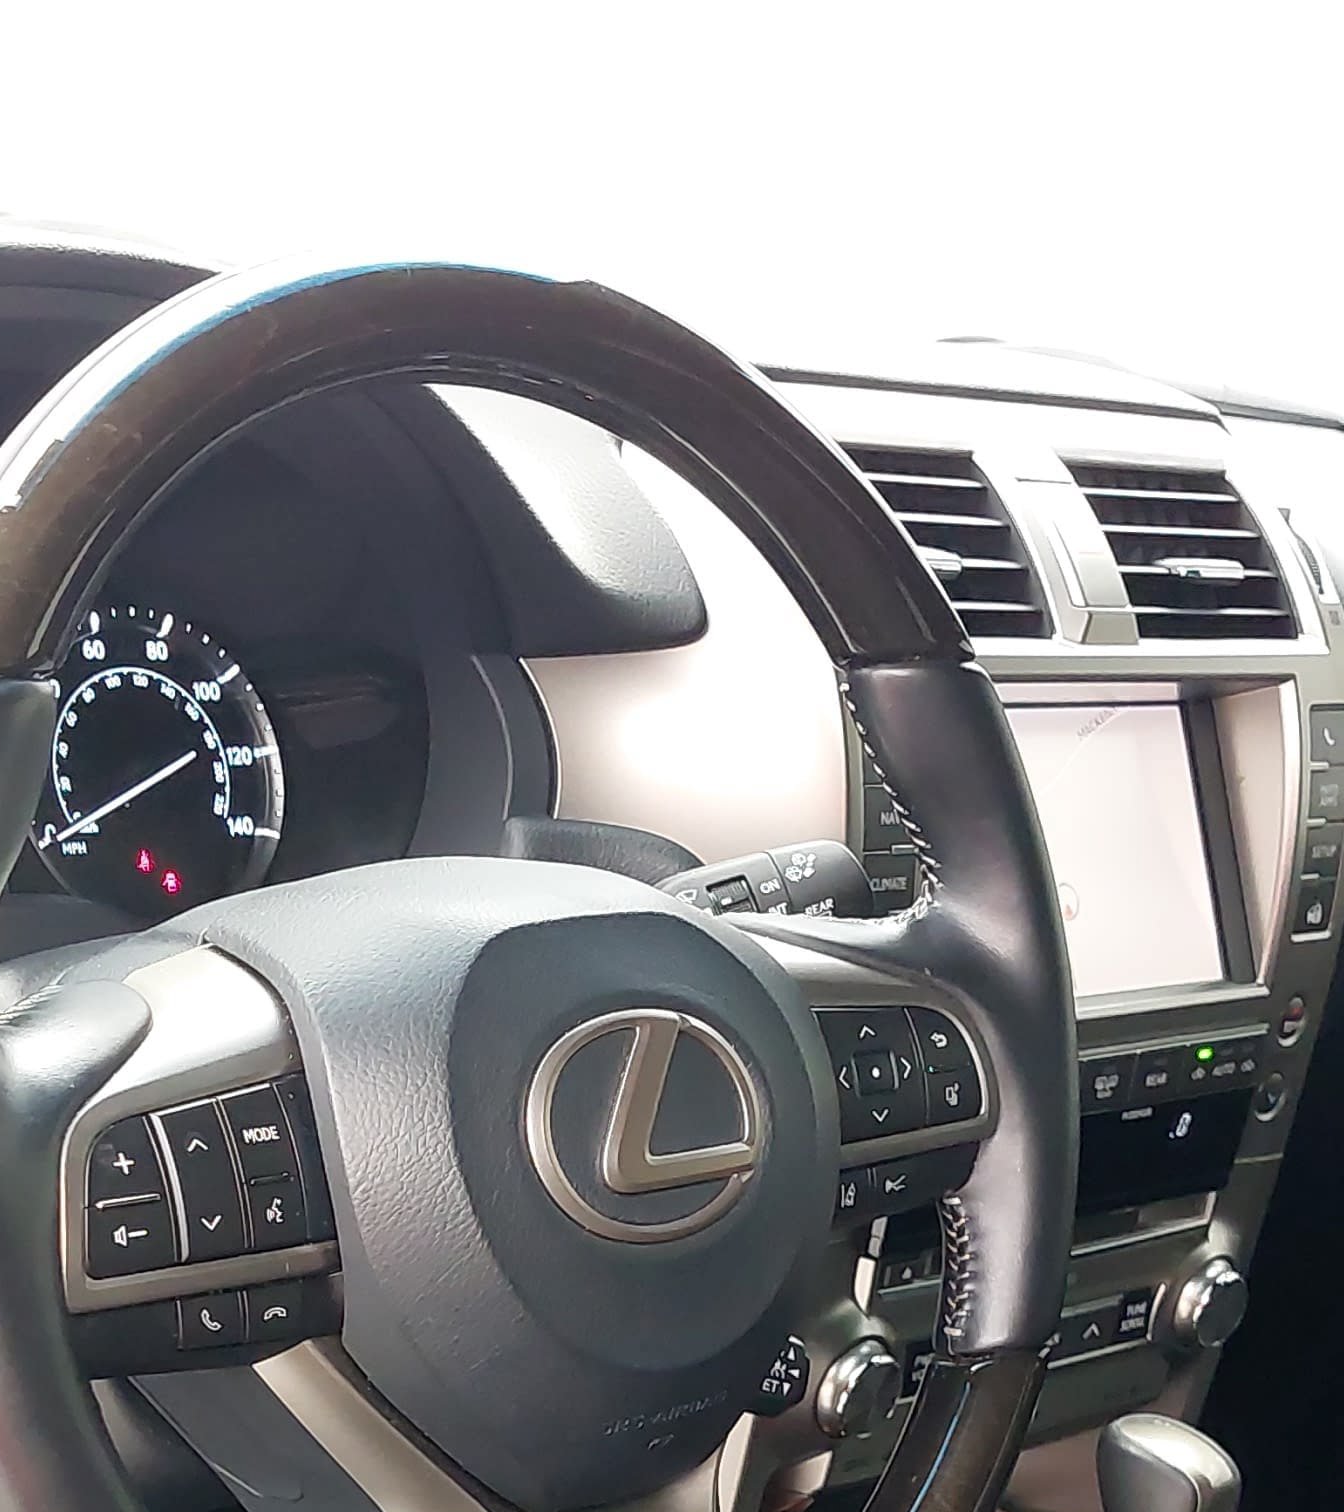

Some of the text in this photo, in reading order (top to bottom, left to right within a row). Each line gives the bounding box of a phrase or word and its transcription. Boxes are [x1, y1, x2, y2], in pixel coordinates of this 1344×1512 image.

[82, 639, 105, 660] 60
[146, 640, 169, 661] 80
[193, 681, 221, 701] 100
[227, 746, 252, 766] 120
[227, 816, 253, 837] 140
[62, 841, 88, 856] MPH
[760, 878, 782, 895] ON
[805, 898, 835, 916] REAR
[242, 1125, 280, 1145] MODE
